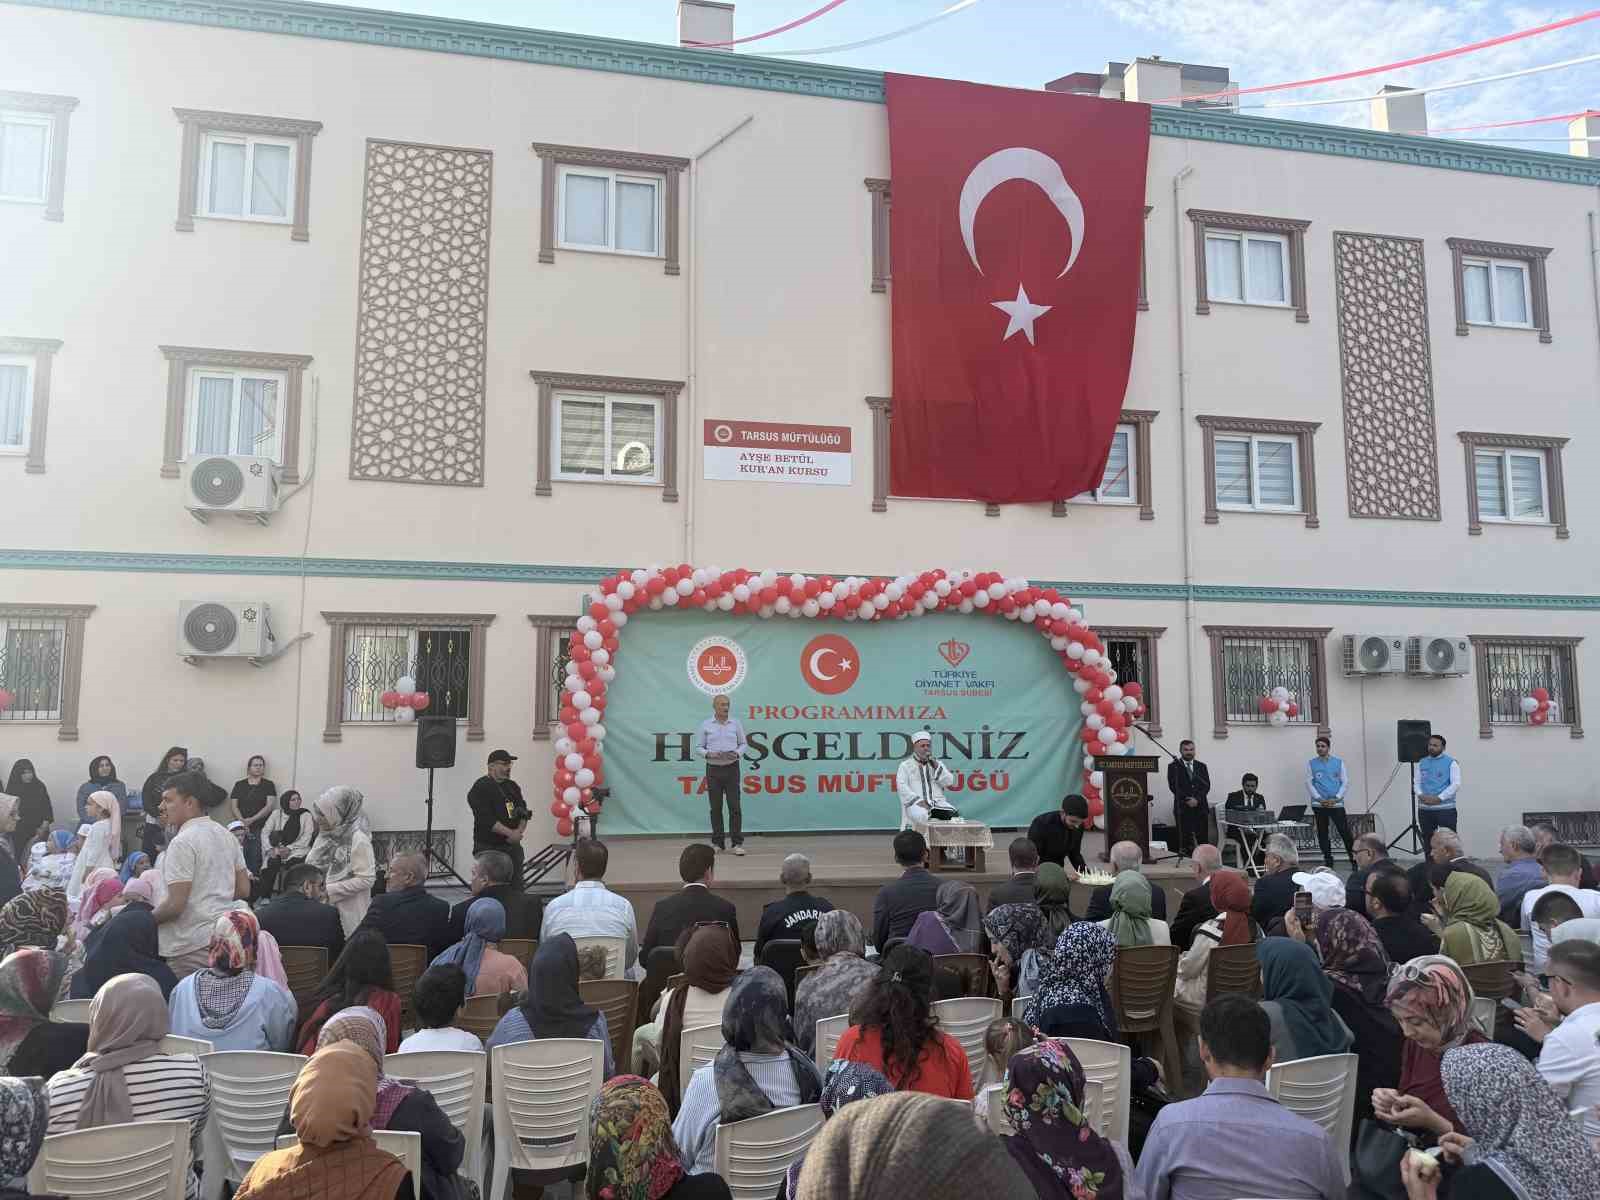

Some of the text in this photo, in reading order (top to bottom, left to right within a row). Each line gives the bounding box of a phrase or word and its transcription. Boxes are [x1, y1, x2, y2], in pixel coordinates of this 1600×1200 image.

[741, 430, 779, 442] TARSUS
[740, 452, 770, 463] AYŞE
[788, 466, 829, 476] KURSU
[748, 704, 947, 720] PROGRAMIMIZA
[651, 724, 1030, 770] HŞGELDNİZ
[677, 769, 1010, 795] TASUS MÜFTÜĞÜ
